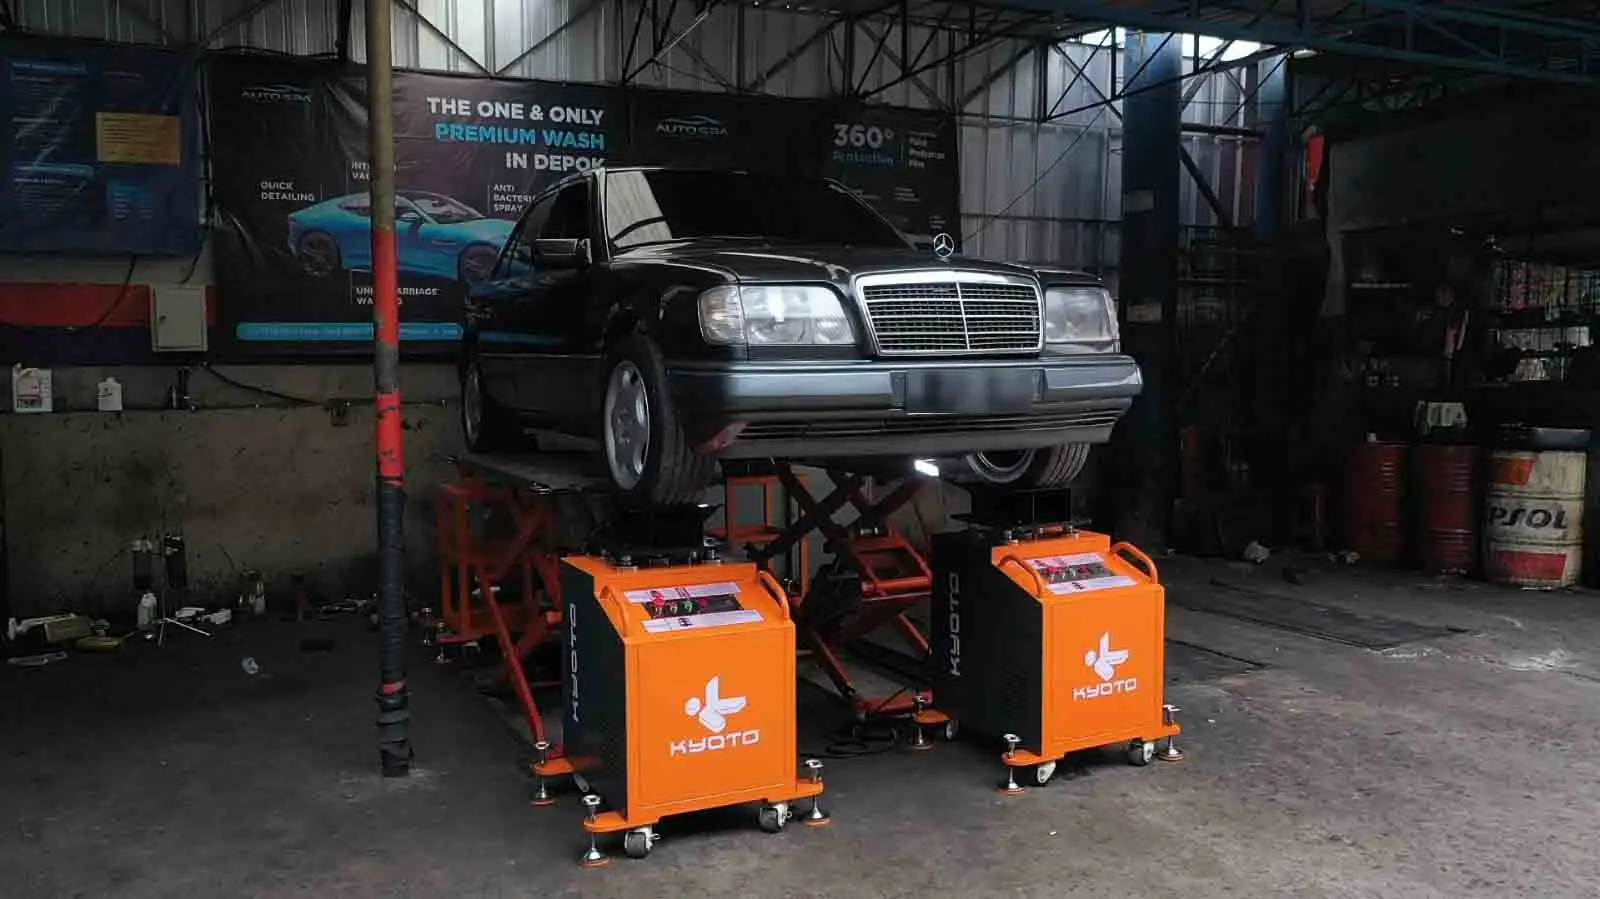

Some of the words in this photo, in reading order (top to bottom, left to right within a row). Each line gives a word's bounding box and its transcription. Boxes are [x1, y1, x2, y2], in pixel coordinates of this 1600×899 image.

[427, 97, 471, 116] THE
[477, 101, 524, 120] ONE
[529, 104, 544, 121] &
[550, 106, 604, 126] ONLY
[436, 123, 536, 145] PREMIUM
[542, 128, 604, 150] WASH
[506, 152, 528, 169] IN
[534, 154, 605, 172] DEPOK
[261, 181, 294, 190] QUICK
[261, 192, 315, 202] DETAILING
[493, 184, 515, 192] ANTI
[494, 203, 524, 212] SPRAY
[947, 572, 963, 677] KYOTO
[568, 602, 581, 722] KYOTO
[1072, 677, 1138, 702] KYOTO
[669, 728, 761, 757] KYOTO
